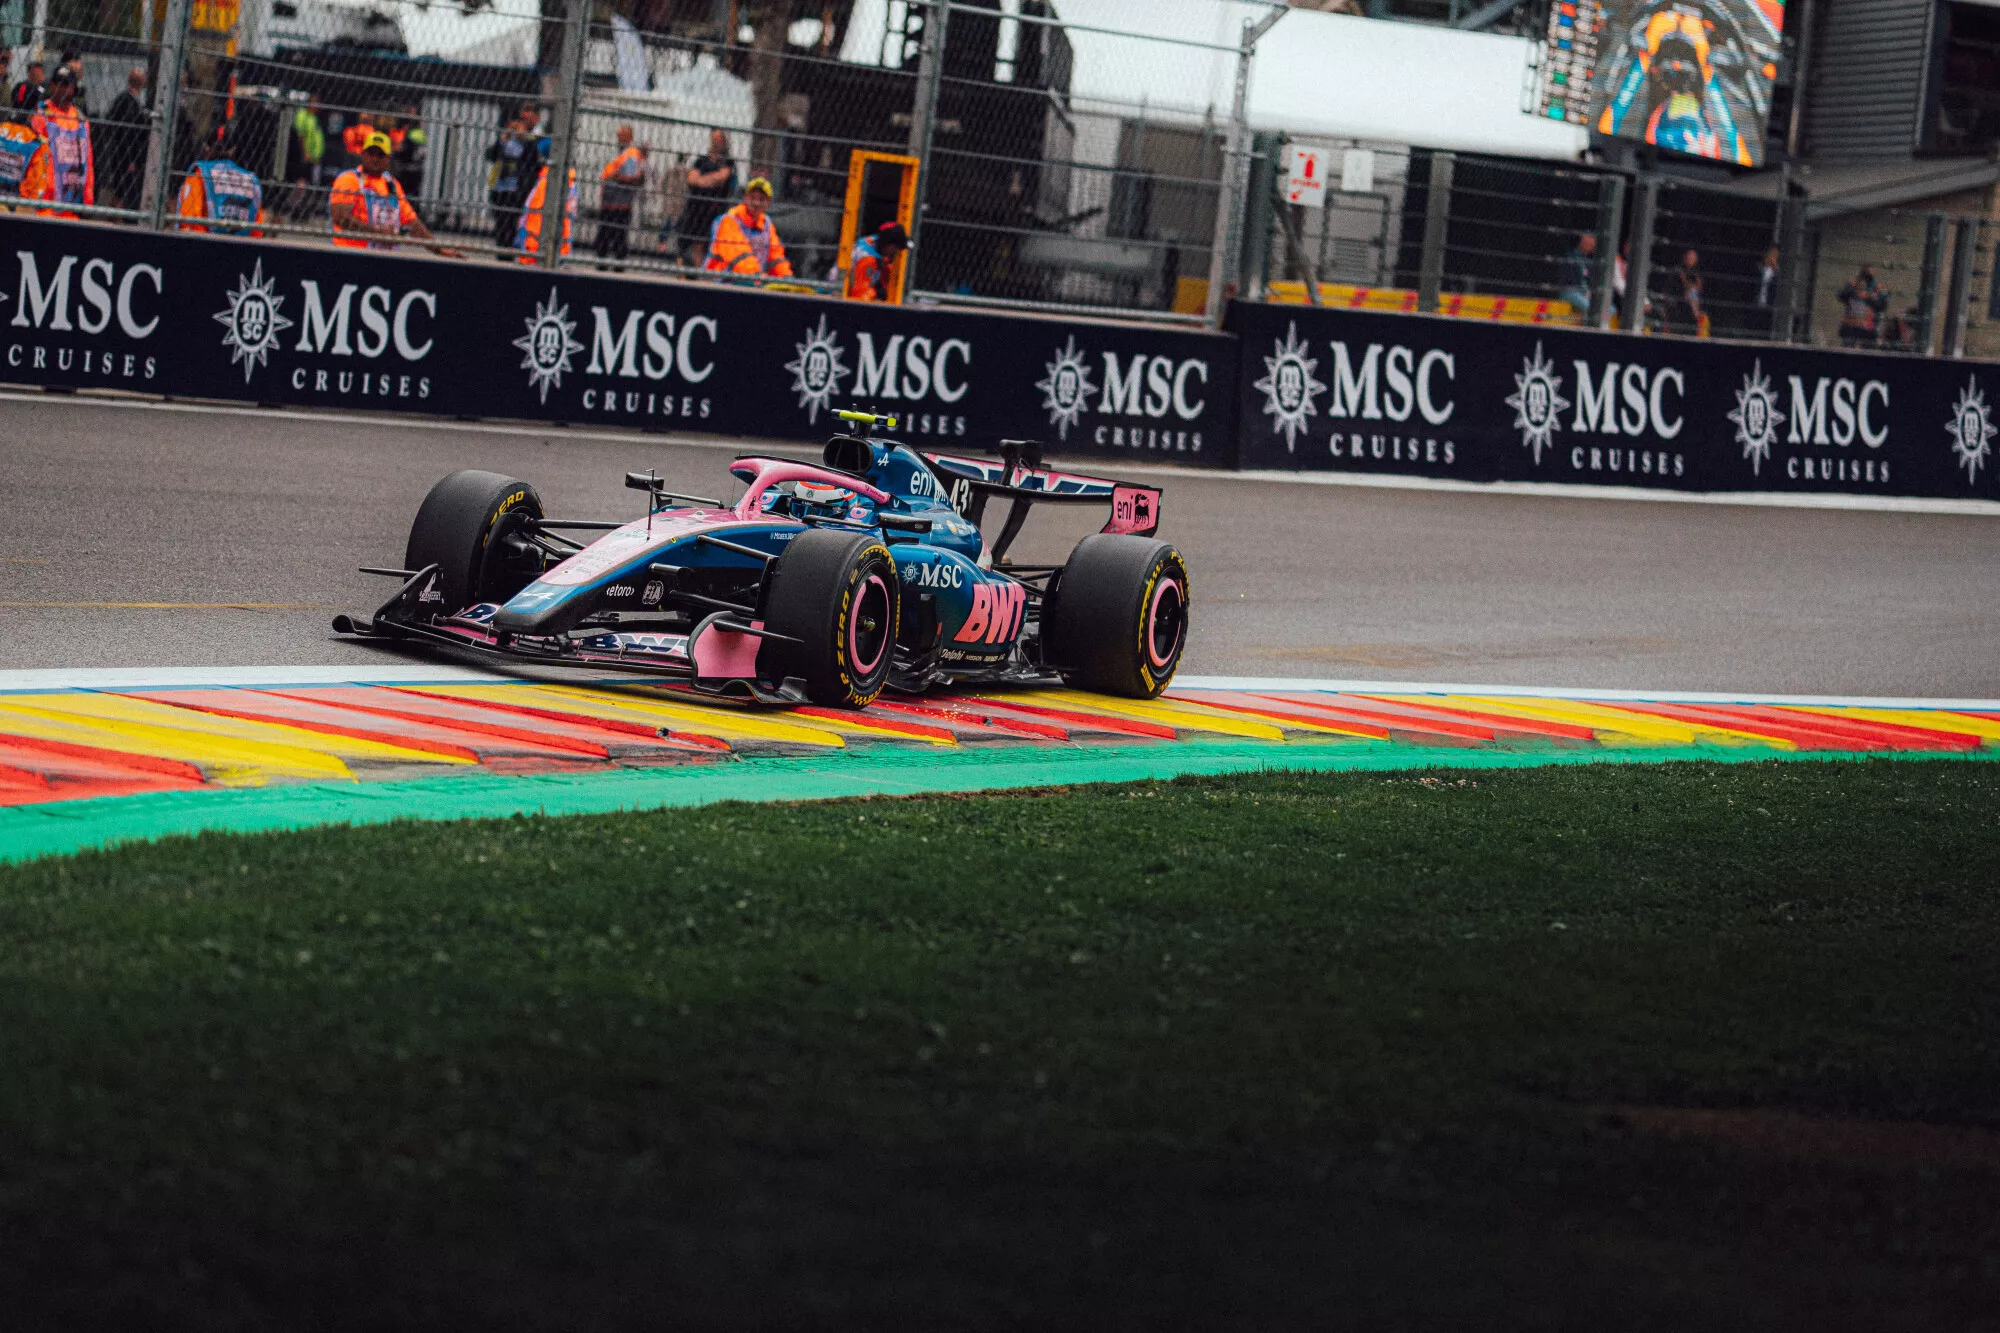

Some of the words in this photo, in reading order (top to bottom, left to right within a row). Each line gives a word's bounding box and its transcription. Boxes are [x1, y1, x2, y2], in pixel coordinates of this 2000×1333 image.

[11, 250, 162, 339] MSC
[295, 279, 436, 361] MSC
[8, 344, 156, 379] CRUISES
[586, 306, 717, 383] MSC
[851, 332, 970, 402] MSC
[292, 368, 430, 398] CRUISES
[583, 388, 710, 418] CRUISES
[1097, 351, 1207, 420] MSC
[1328, 340, 1454, 425] MSC
[1571, 360, 1684, 439] MSC
[1787, 375, 1889, 448] MSC
[1095, 425, 1202, 451] CRUISES
[1329, 433, 1455, 464] CRUISES
[1571, 446, 1684, 476] CRUISES
[1787, 456, 1890, 483] CRUISES
[1117, 495, 1134, 520] eni
[917, 562, 962, 588] MSC
[837, 590, 850, 667] ZERO
[953, 582, 1026, 644] BWT
[941, 648, 965, 661] Delphi
